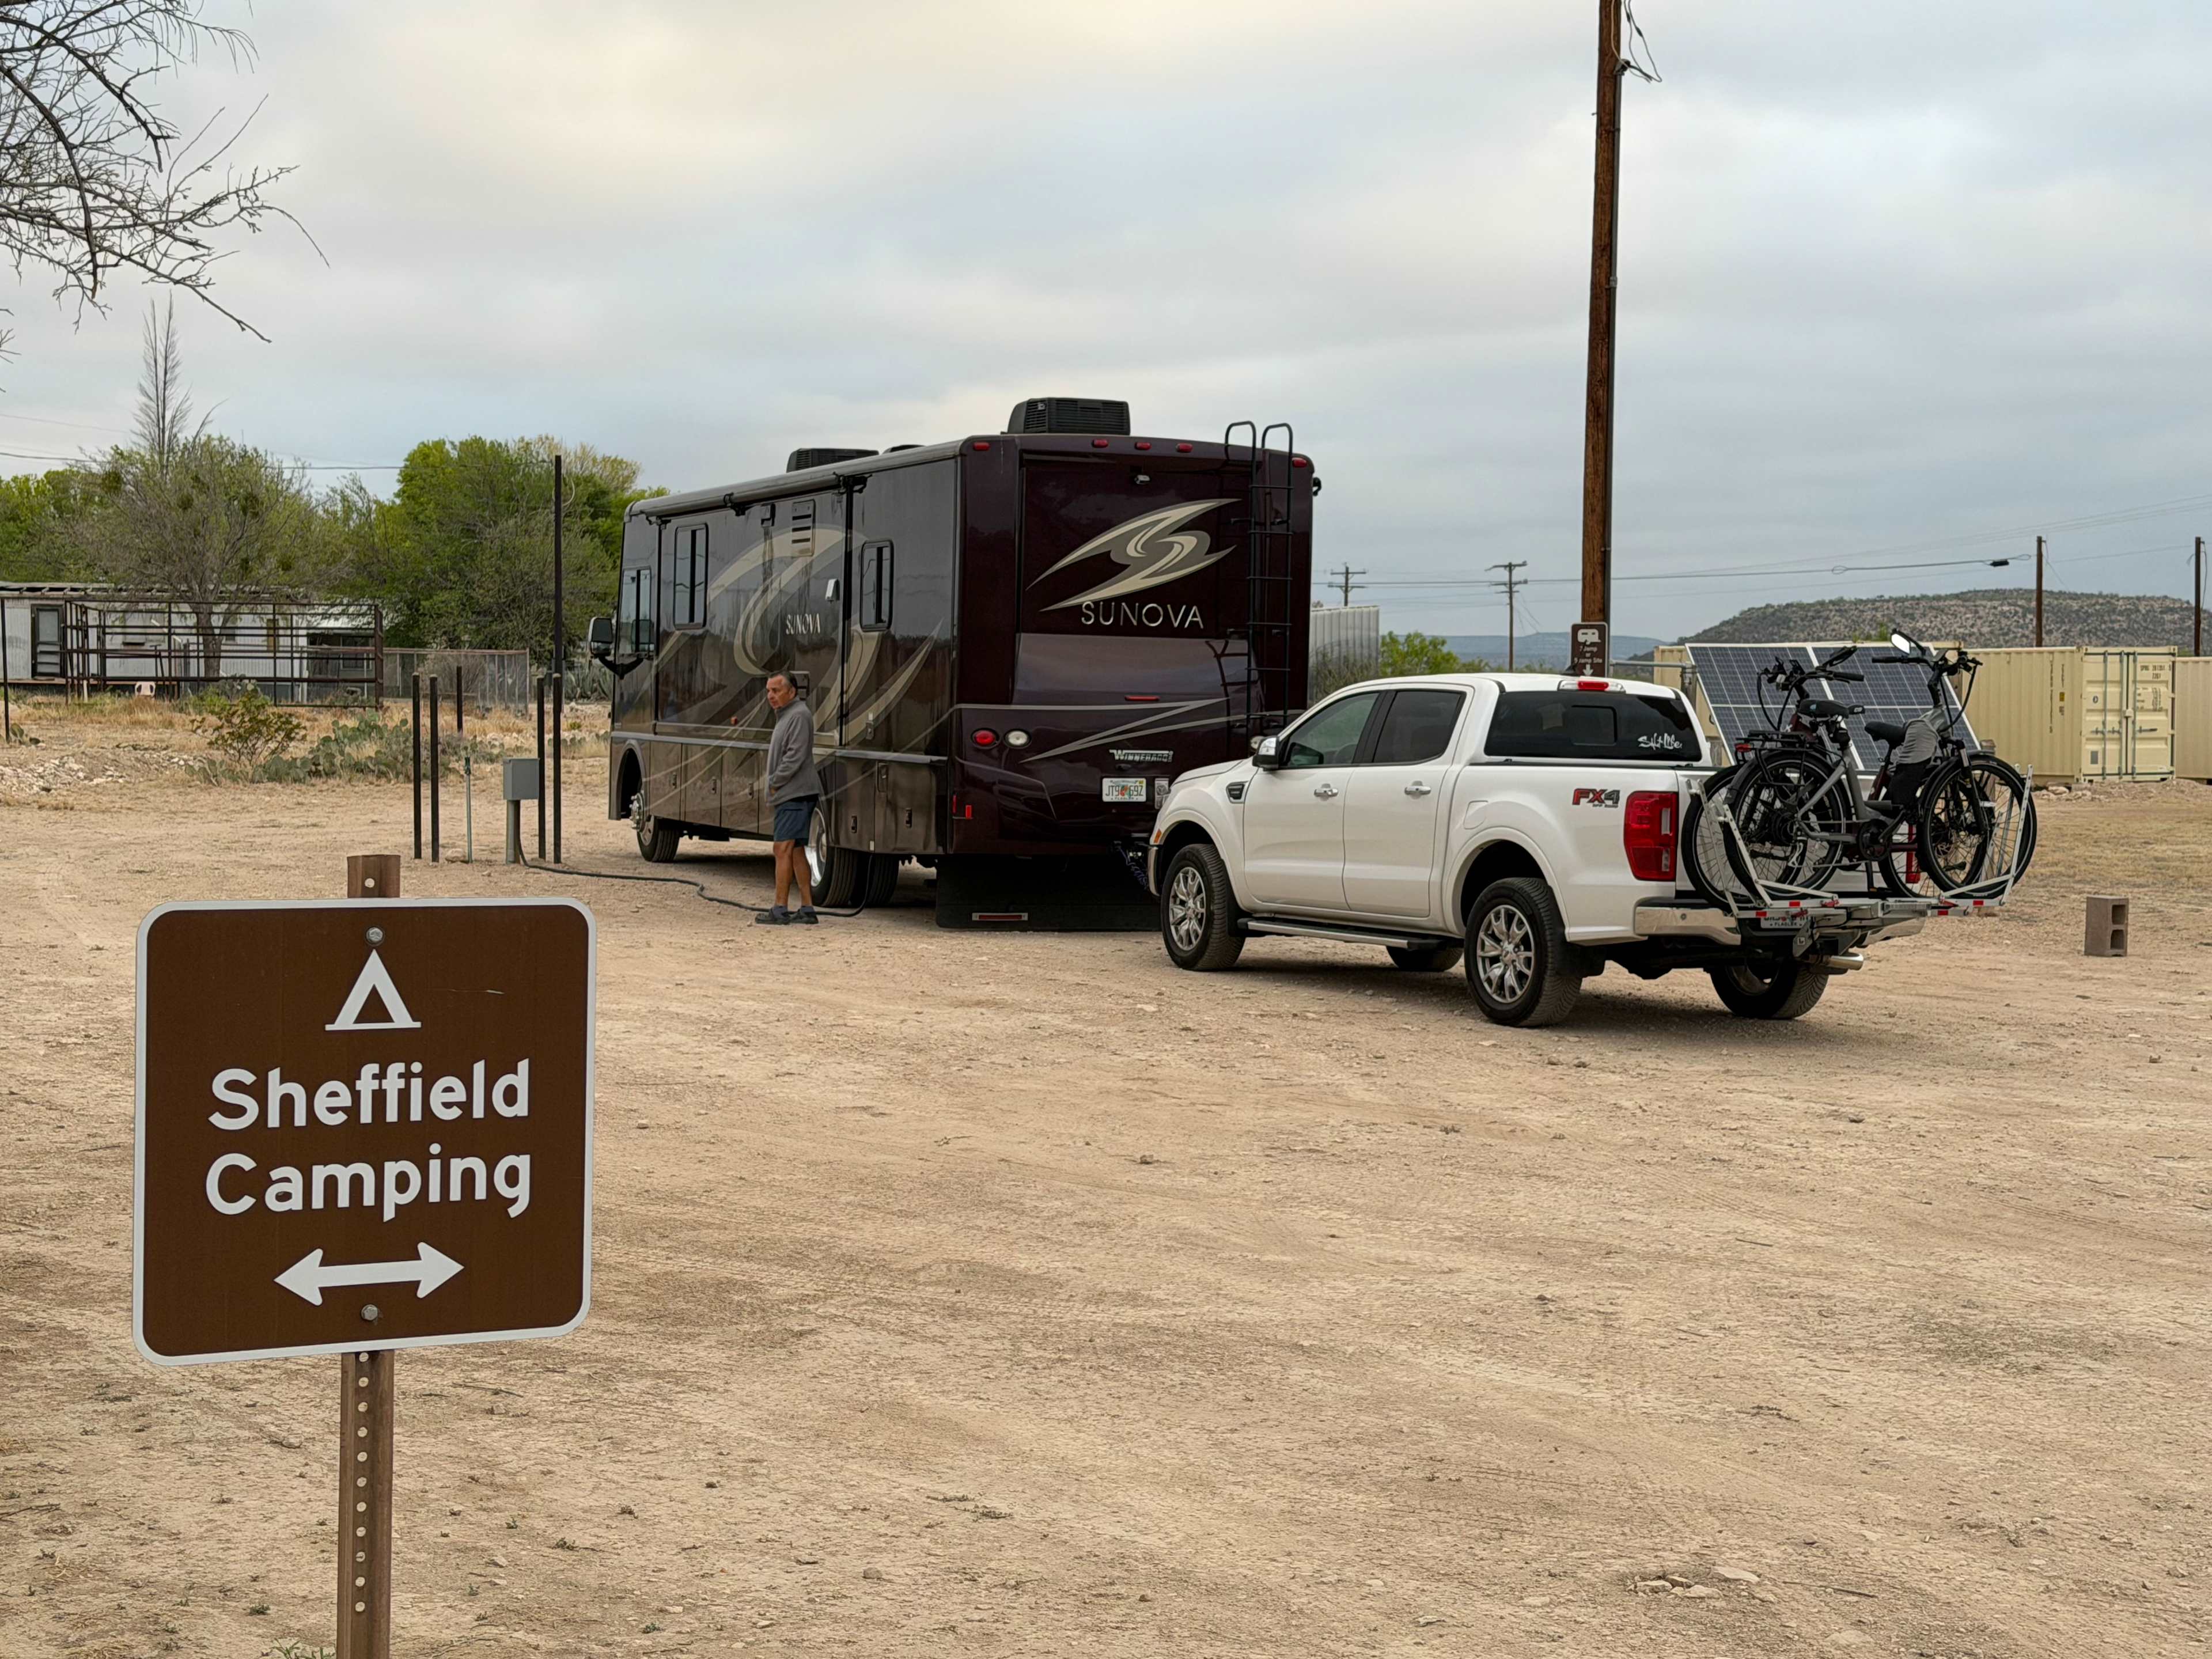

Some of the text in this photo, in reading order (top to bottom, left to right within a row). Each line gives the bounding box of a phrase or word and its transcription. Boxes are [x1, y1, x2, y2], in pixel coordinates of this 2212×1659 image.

[786, 613, 820, 635] SUNOVA
[1081, 601, 1204, 629] SUNOVA
[1572, 789, 1620, 805] FX4
[208, 1058, 529, 1131] Sheffield
[206, 1143, 531, 1222] Camping
